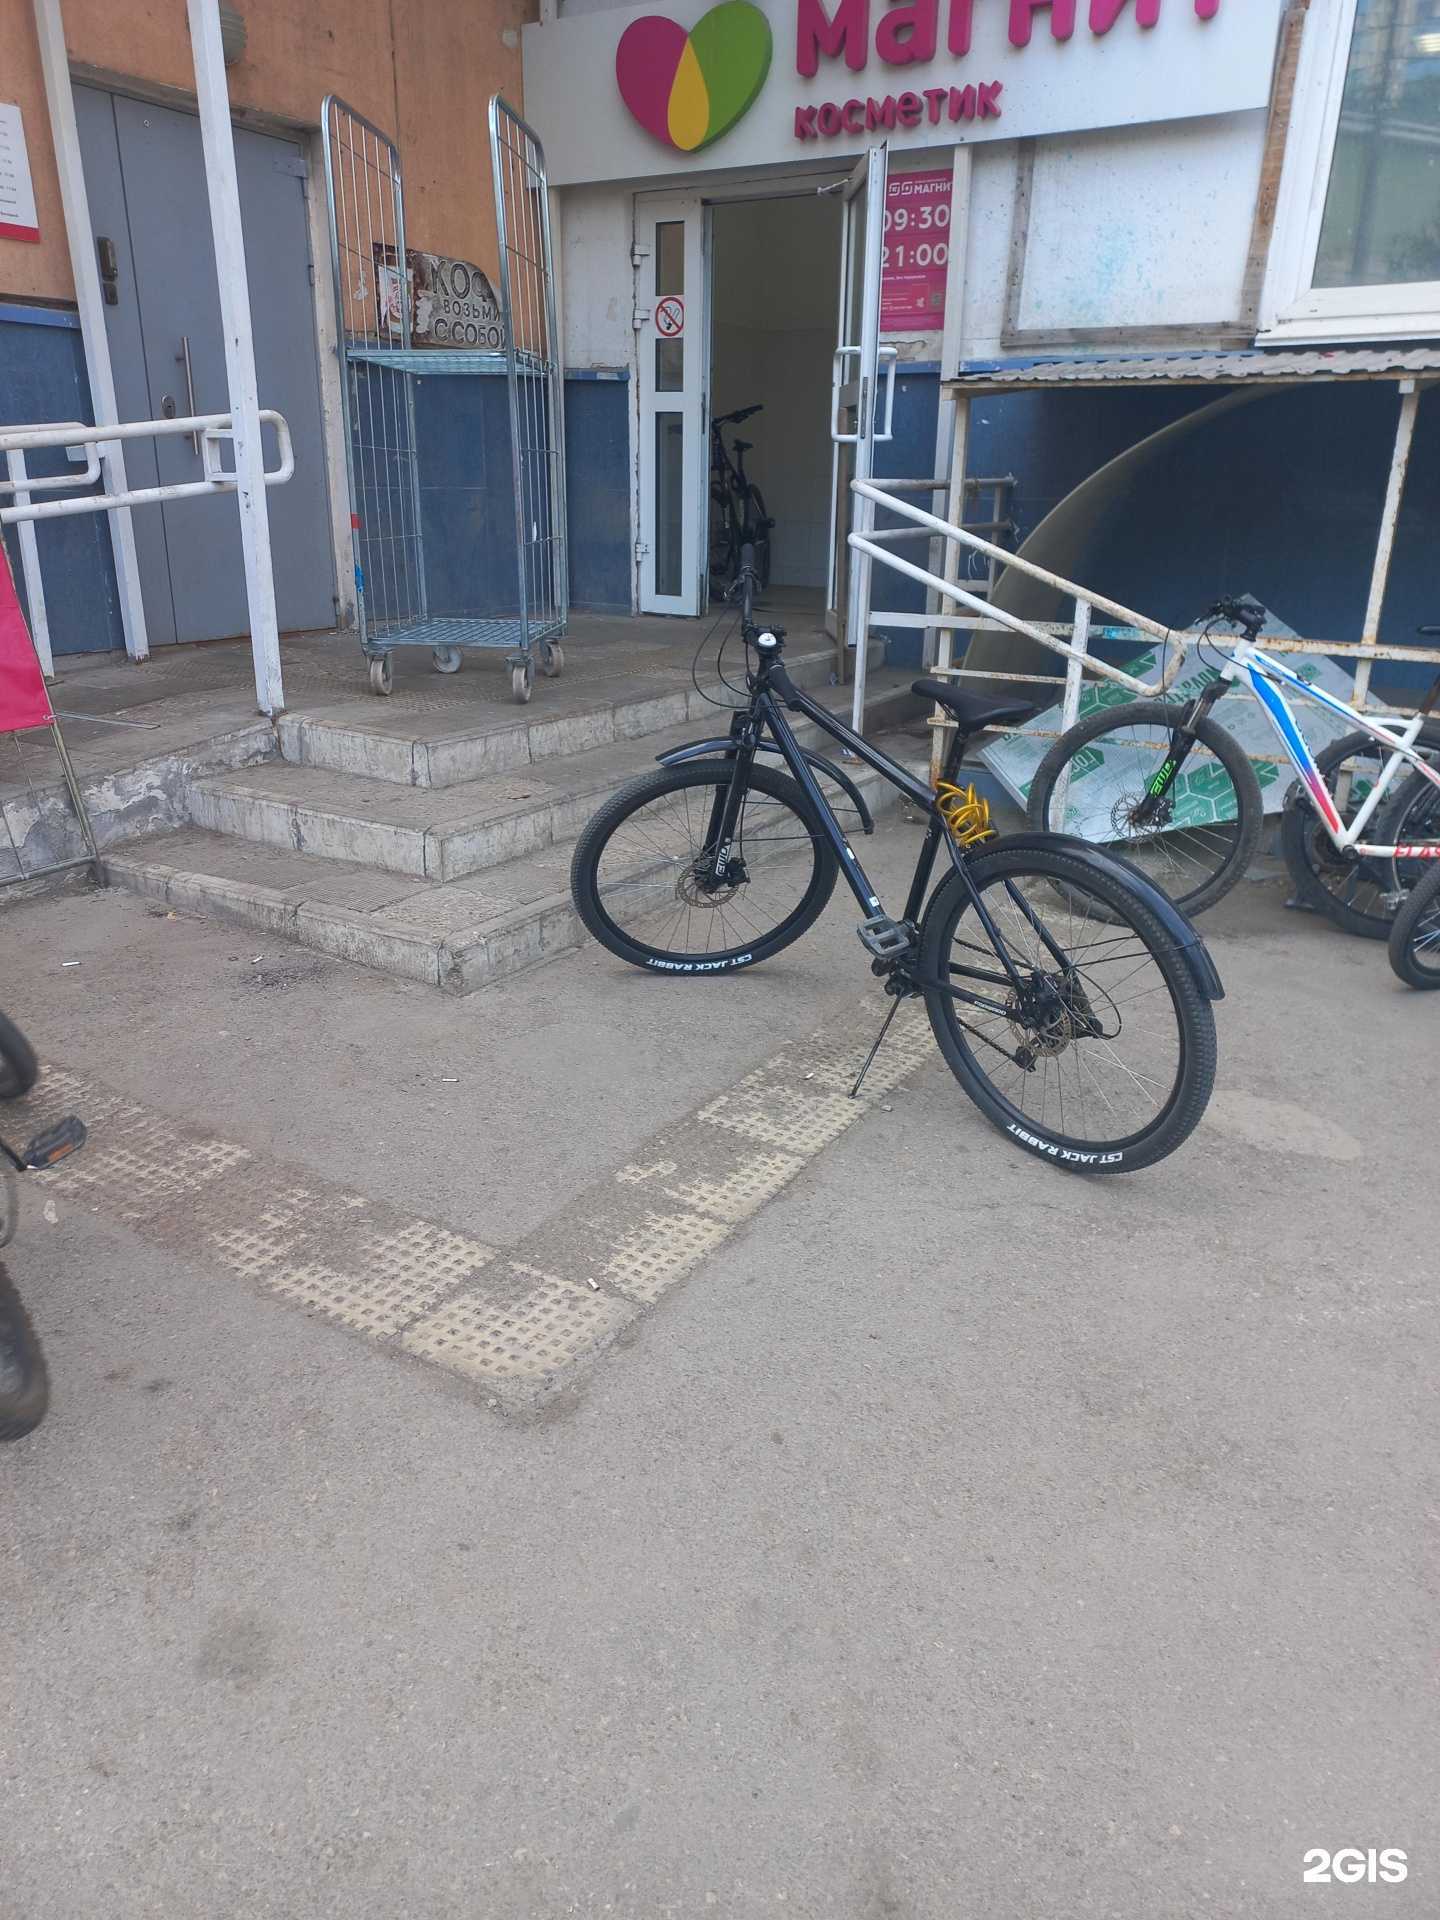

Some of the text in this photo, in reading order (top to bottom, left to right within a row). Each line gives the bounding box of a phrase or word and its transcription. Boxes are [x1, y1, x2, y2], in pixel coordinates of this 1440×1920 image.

[794, 80, 1003, 140] косметик
[914, 183, 953, 195] МАГНИ
[646, 958, 693, 971] RABBIT
[695, 960, 728, 971] JACK
[1006, 1123, 1123, 1164] CST JACK RABBIT
